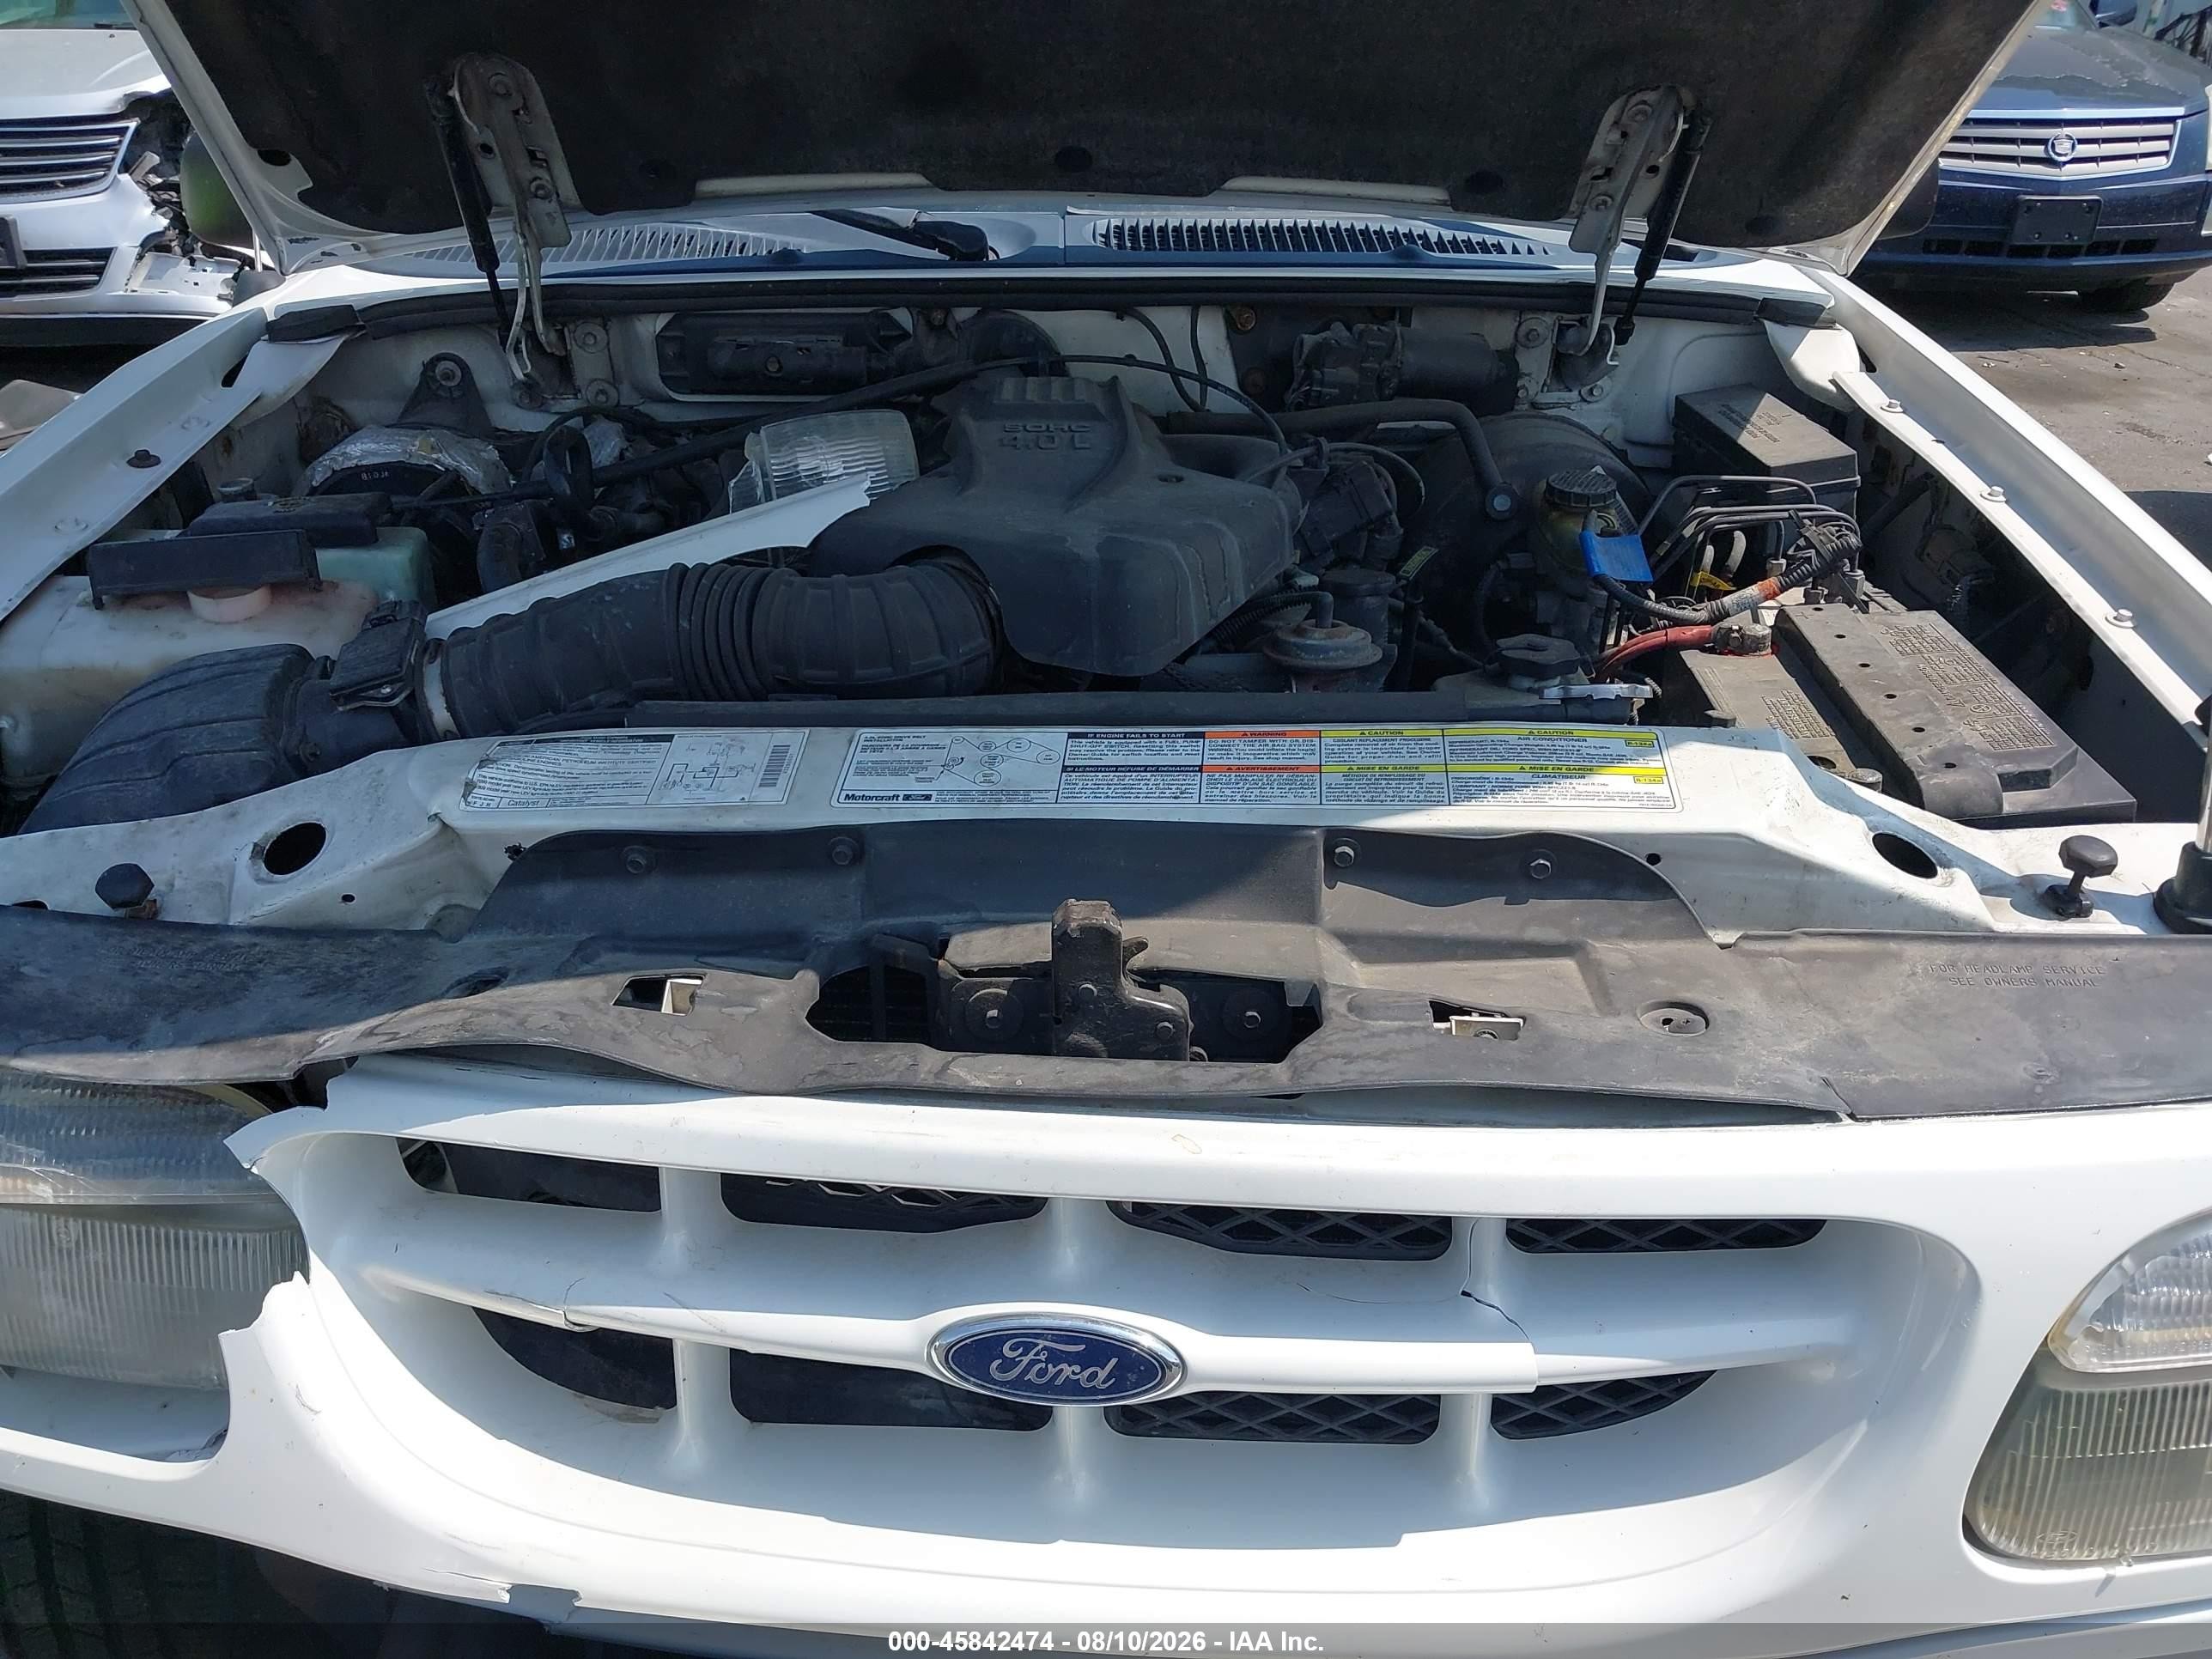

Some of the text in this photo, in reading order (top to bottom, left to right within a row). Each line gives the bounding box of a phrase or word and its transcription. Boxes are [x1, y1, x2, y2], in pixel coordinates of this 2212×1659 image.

[1003, 422, 1092, 433] SOHC
[1929, 964, 2106, 975] FOR HEADLAMP SERVICE
[1948, 977, 2099, 988] SEE OWNERS MANUAL
[989, 1337, 1119, 1389] Ford
